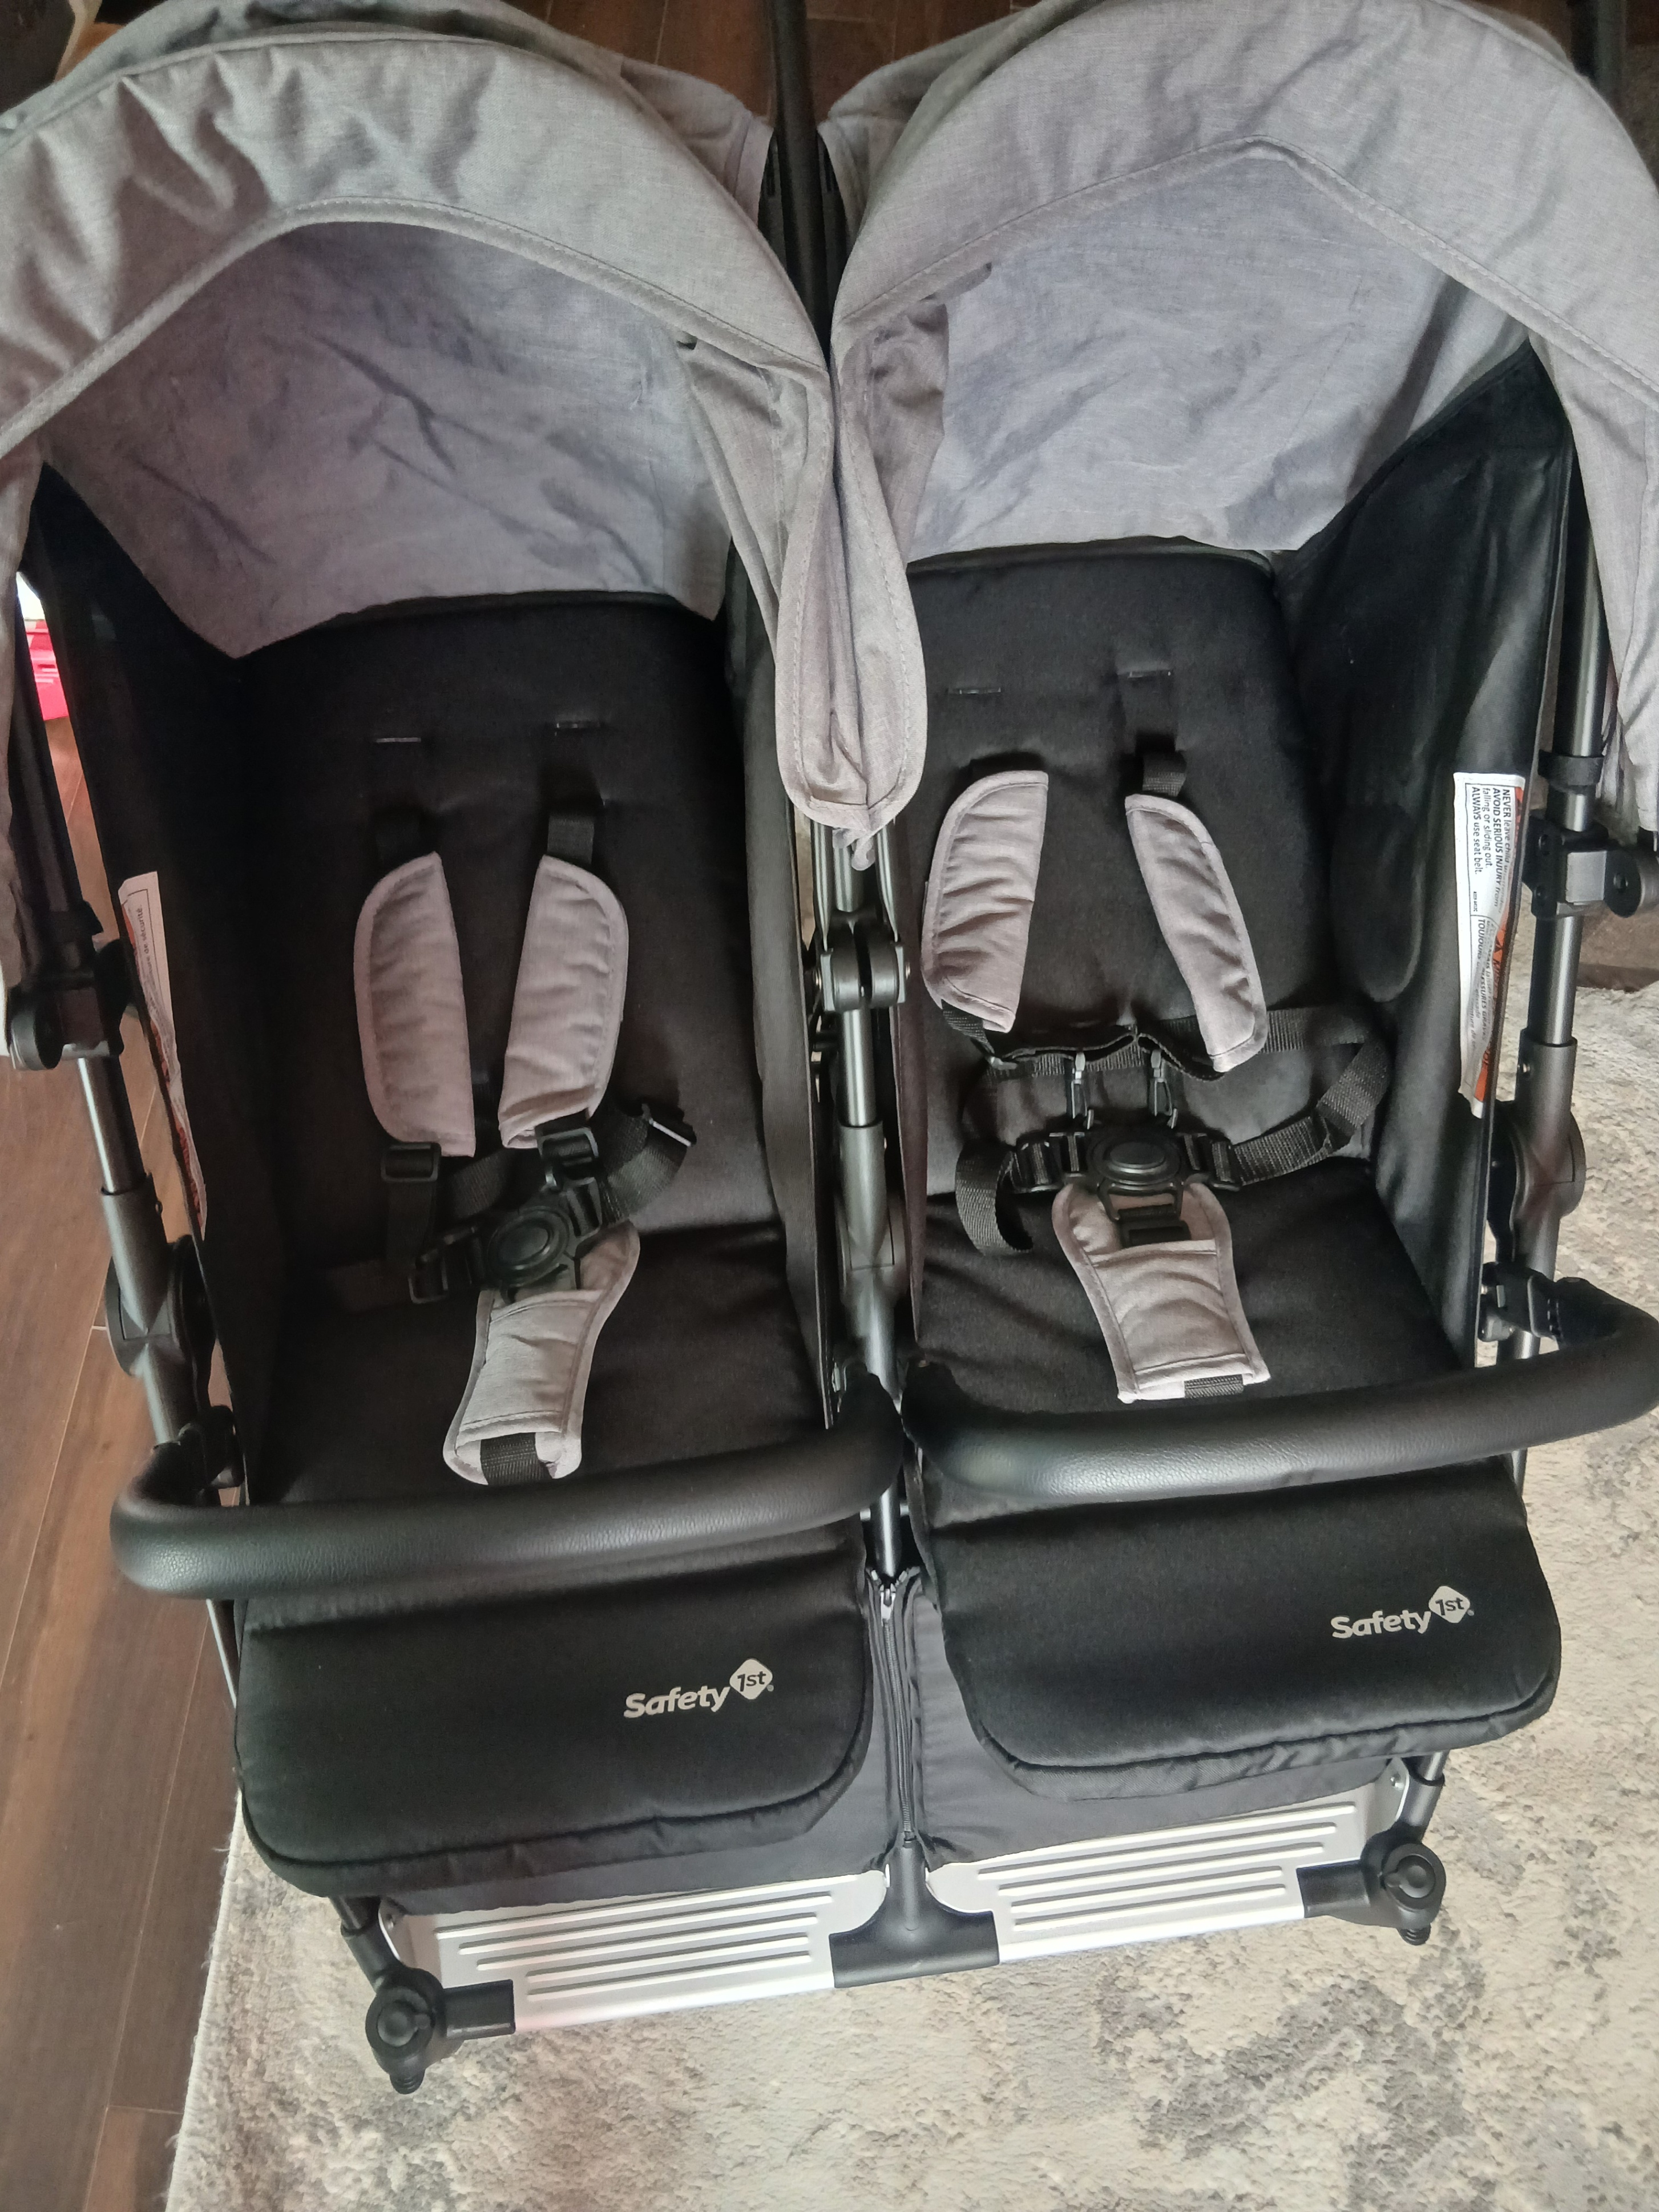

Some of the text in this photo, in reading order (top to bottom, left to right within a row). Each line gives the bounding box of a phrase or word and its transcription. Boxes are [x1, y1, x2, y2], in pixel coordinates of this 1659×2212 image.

[1472, 786, 1482, 820] ALWAYS
[1482, 788, 1491, 812] falling
[1493, 788, 1501, 816] AVOID
[1502, 789, 1511, 818] NEVER
[1483, 814, 1490, 824] or
[1482, 825, 1492, 851] sliding
[1493, 818, 1503, 853] SERIOUS
[1474, 857, 1484, 875] belt.
[1477, 919, 1486, 960] TOUJOURS
[1330, 1597, 1465, 1639] Safety 1st
[623, 1670, 767, 1719] Safety 1st
